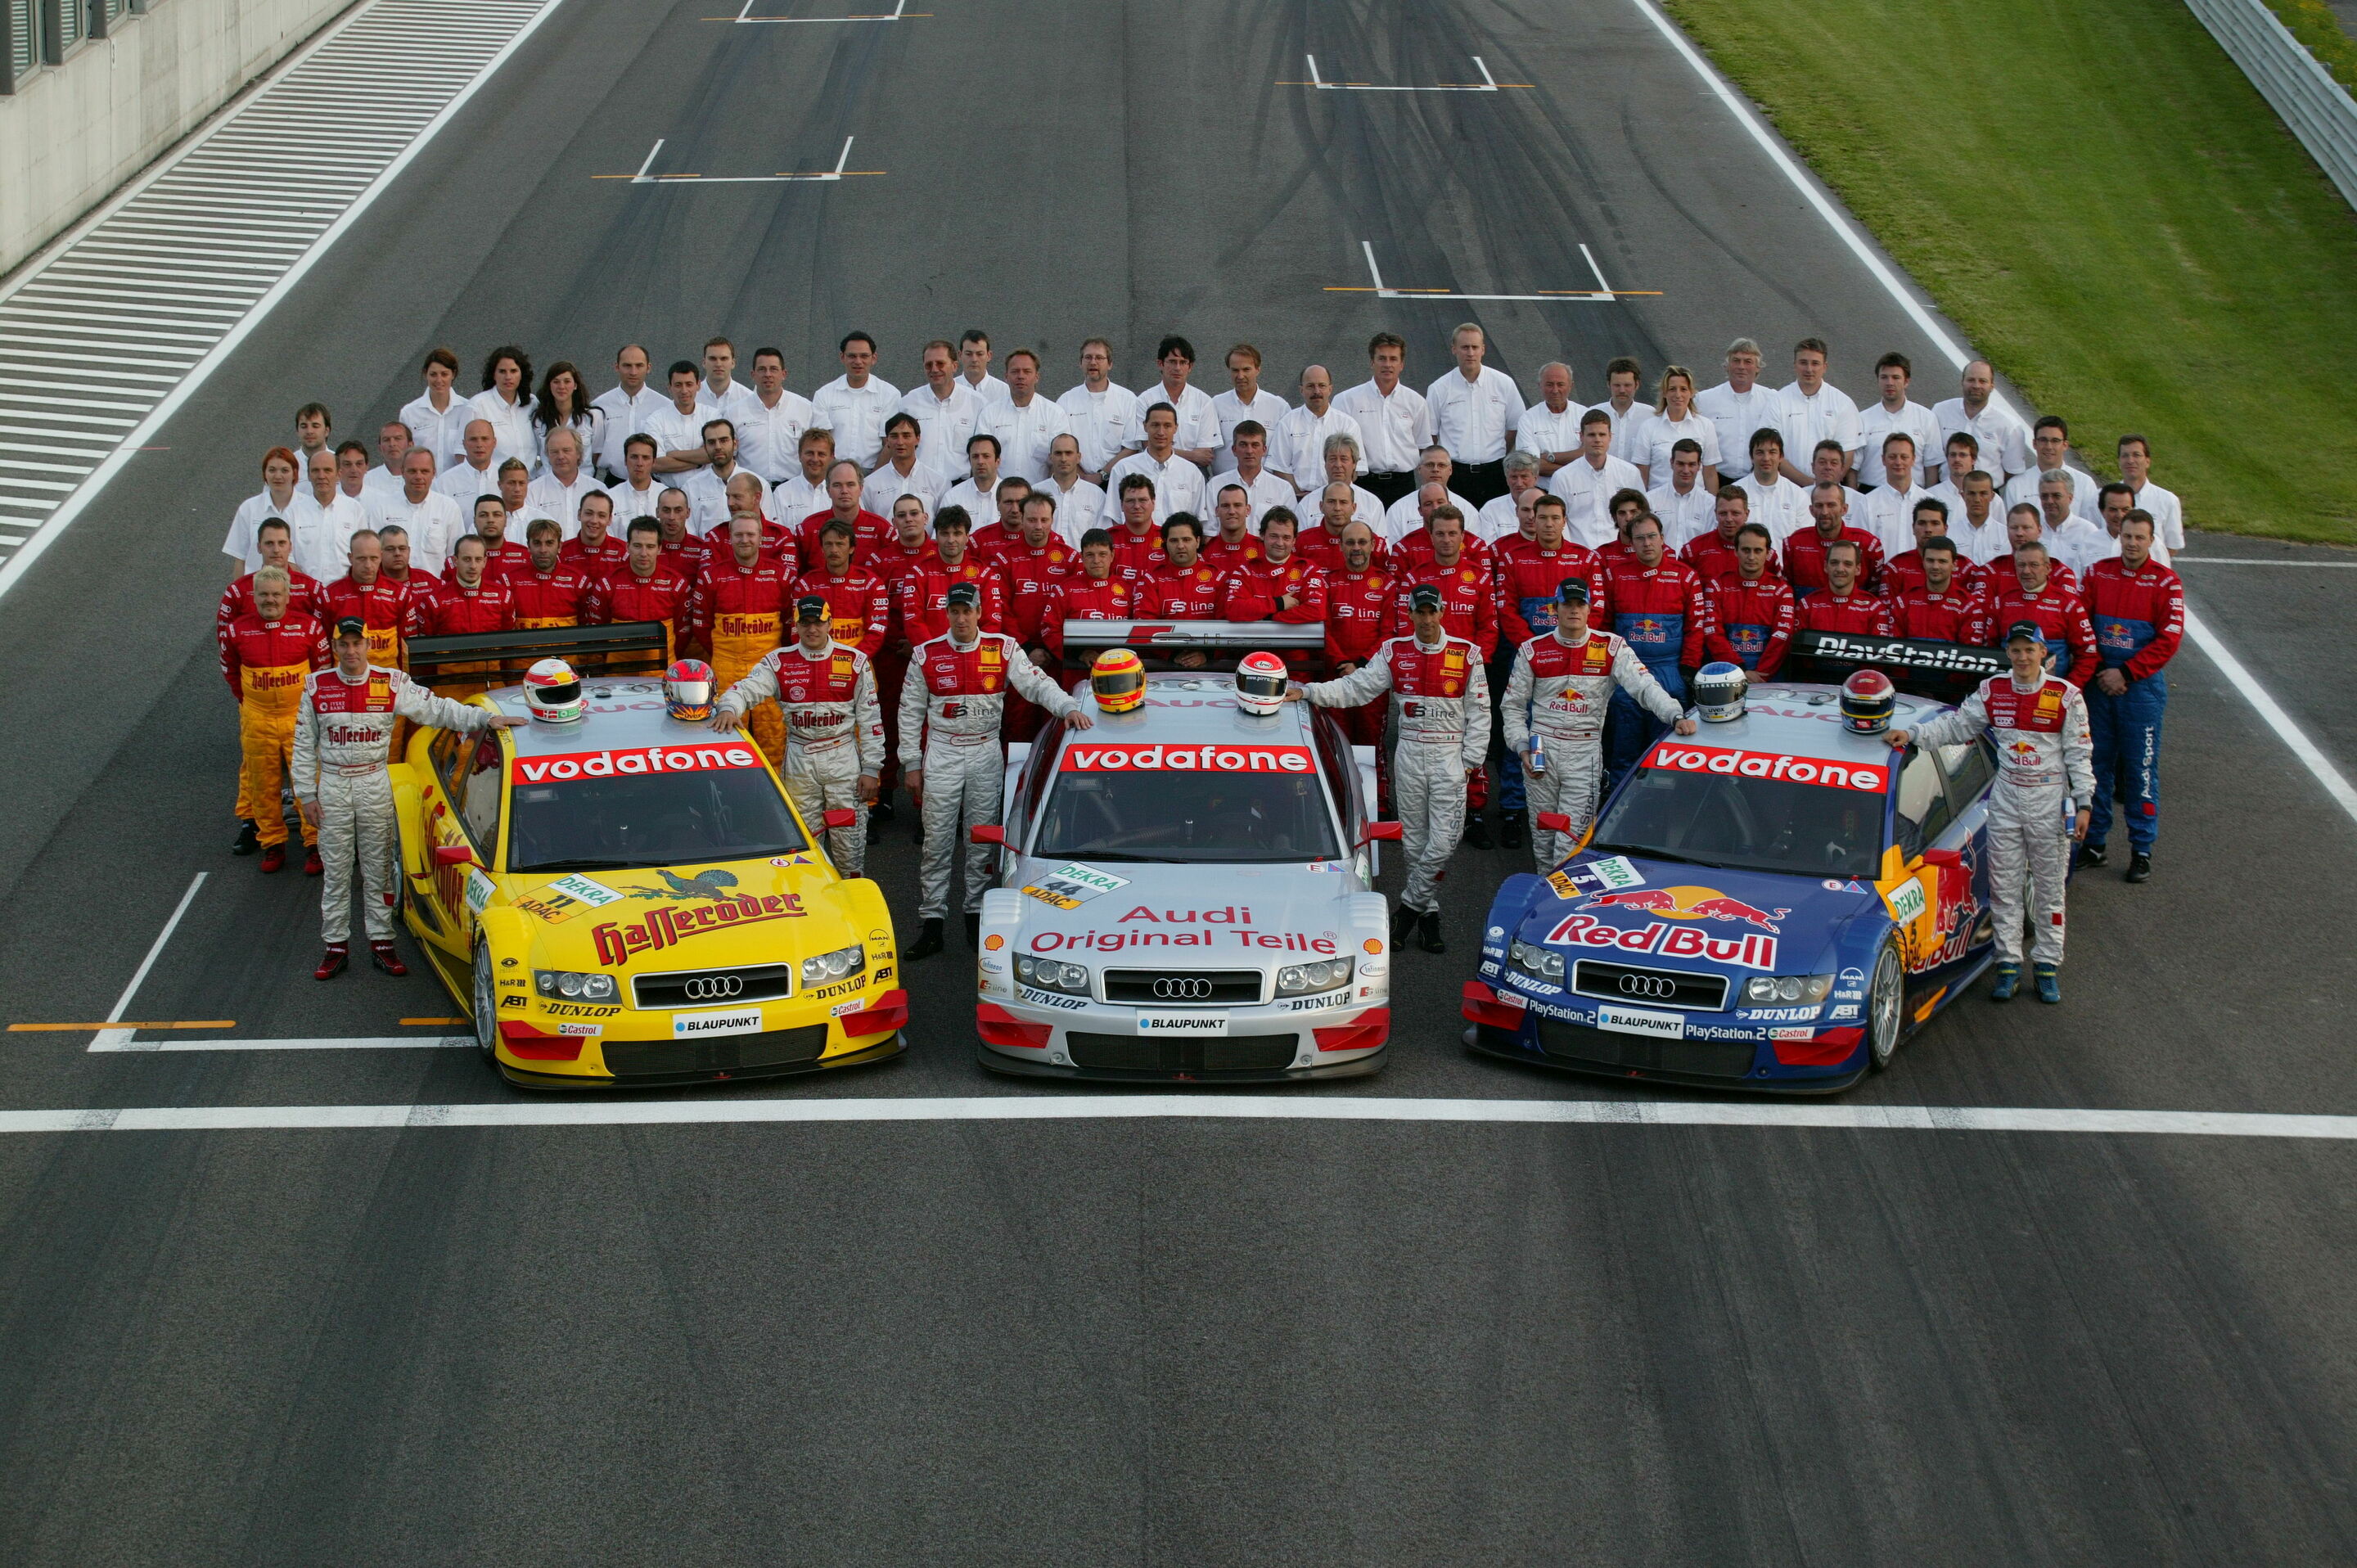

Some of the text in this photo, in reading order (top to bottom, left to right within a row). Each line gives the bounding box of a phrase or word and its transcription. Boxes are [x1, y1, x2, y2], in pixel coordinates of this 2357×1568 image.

[1190, 602, 1215, 612] line
[1359, 608, 1381, 619] line
[1450, 601, 1475, 612] line
[1533, 616, 1549, 626] Red
[1629, 631, 1666, 643] Red Bull
[2115, 636, 2134, 649] Bull
[1744, 642, 1764, 653] Bull
[1814, 637, 1998, 674] PlayStation
[1431, 707, 1456, 719] line
[1549, 701, 1589, 714] Red Bull
[521, 746, 755, 782] vodafone
[1074, 746, 1308, 771] vodafone
[2021, 755, 2042, 767] Bull
[2140, 725, 2155, 800] Audi Sport
[1656, 748, 1881, 790] vodafone
[1056, 866, 1120, 891] DEKRA
[1570, 874, 1598, 885] 5
[1596, 858, 1636, 887] DEKRA
[467, 874, 487, 908] DEKRA
[555, 876, 613, 905] DEKRA
[1044, 881, 1084, 896] 44
[547, 894, 576, 908] 11
[1030, 889, 1072, 907] ADAC
[1894, 885, 1925, 921] DEKRA
[518, 899, 561, 921] ADAC
[1116, 906, 1252, 925] Audi
[1909, 921, 1918, 945] 5
[1030, 929, 1213, 953] Original
[1544, 914, 1778, 972] Red Bull
[982, 959, 1003, 972] Infineon
[1480, 960, 1503, 975] ABT
[873, 966, 894, 985] ABT
[1506, 971, 1563, 995] DUNLOP
[815, 975, 867, 1000] DUNLOP
[992, 982, 1007, 994] line
[500, 994, 529, 1008] ABT
[1021, 987, 1088, 1011] DUNLOP
[1290, 992, 1350, 1012] DUNLOP
[1502, 991, 1525, 1007] Castrol
[546, 1003, 622, 1018] DUNLOP
[837, 1001, 861, 1016] Castrol
[1747, 1006, 1822, 1021] DUNLOP
[1829, 1004, 1860, 1019] ABT
[568, 1024, 597, 1035] Castrol
[687, 1016, 760, 1033] BLAUPUNKT
[1151, 1017, 1227, 1030] BLAUPUNKT
[1610, 1014, 1682, 1033] BLAUPUNKT
[1778, 1028, 1809, 1039] Castrol
